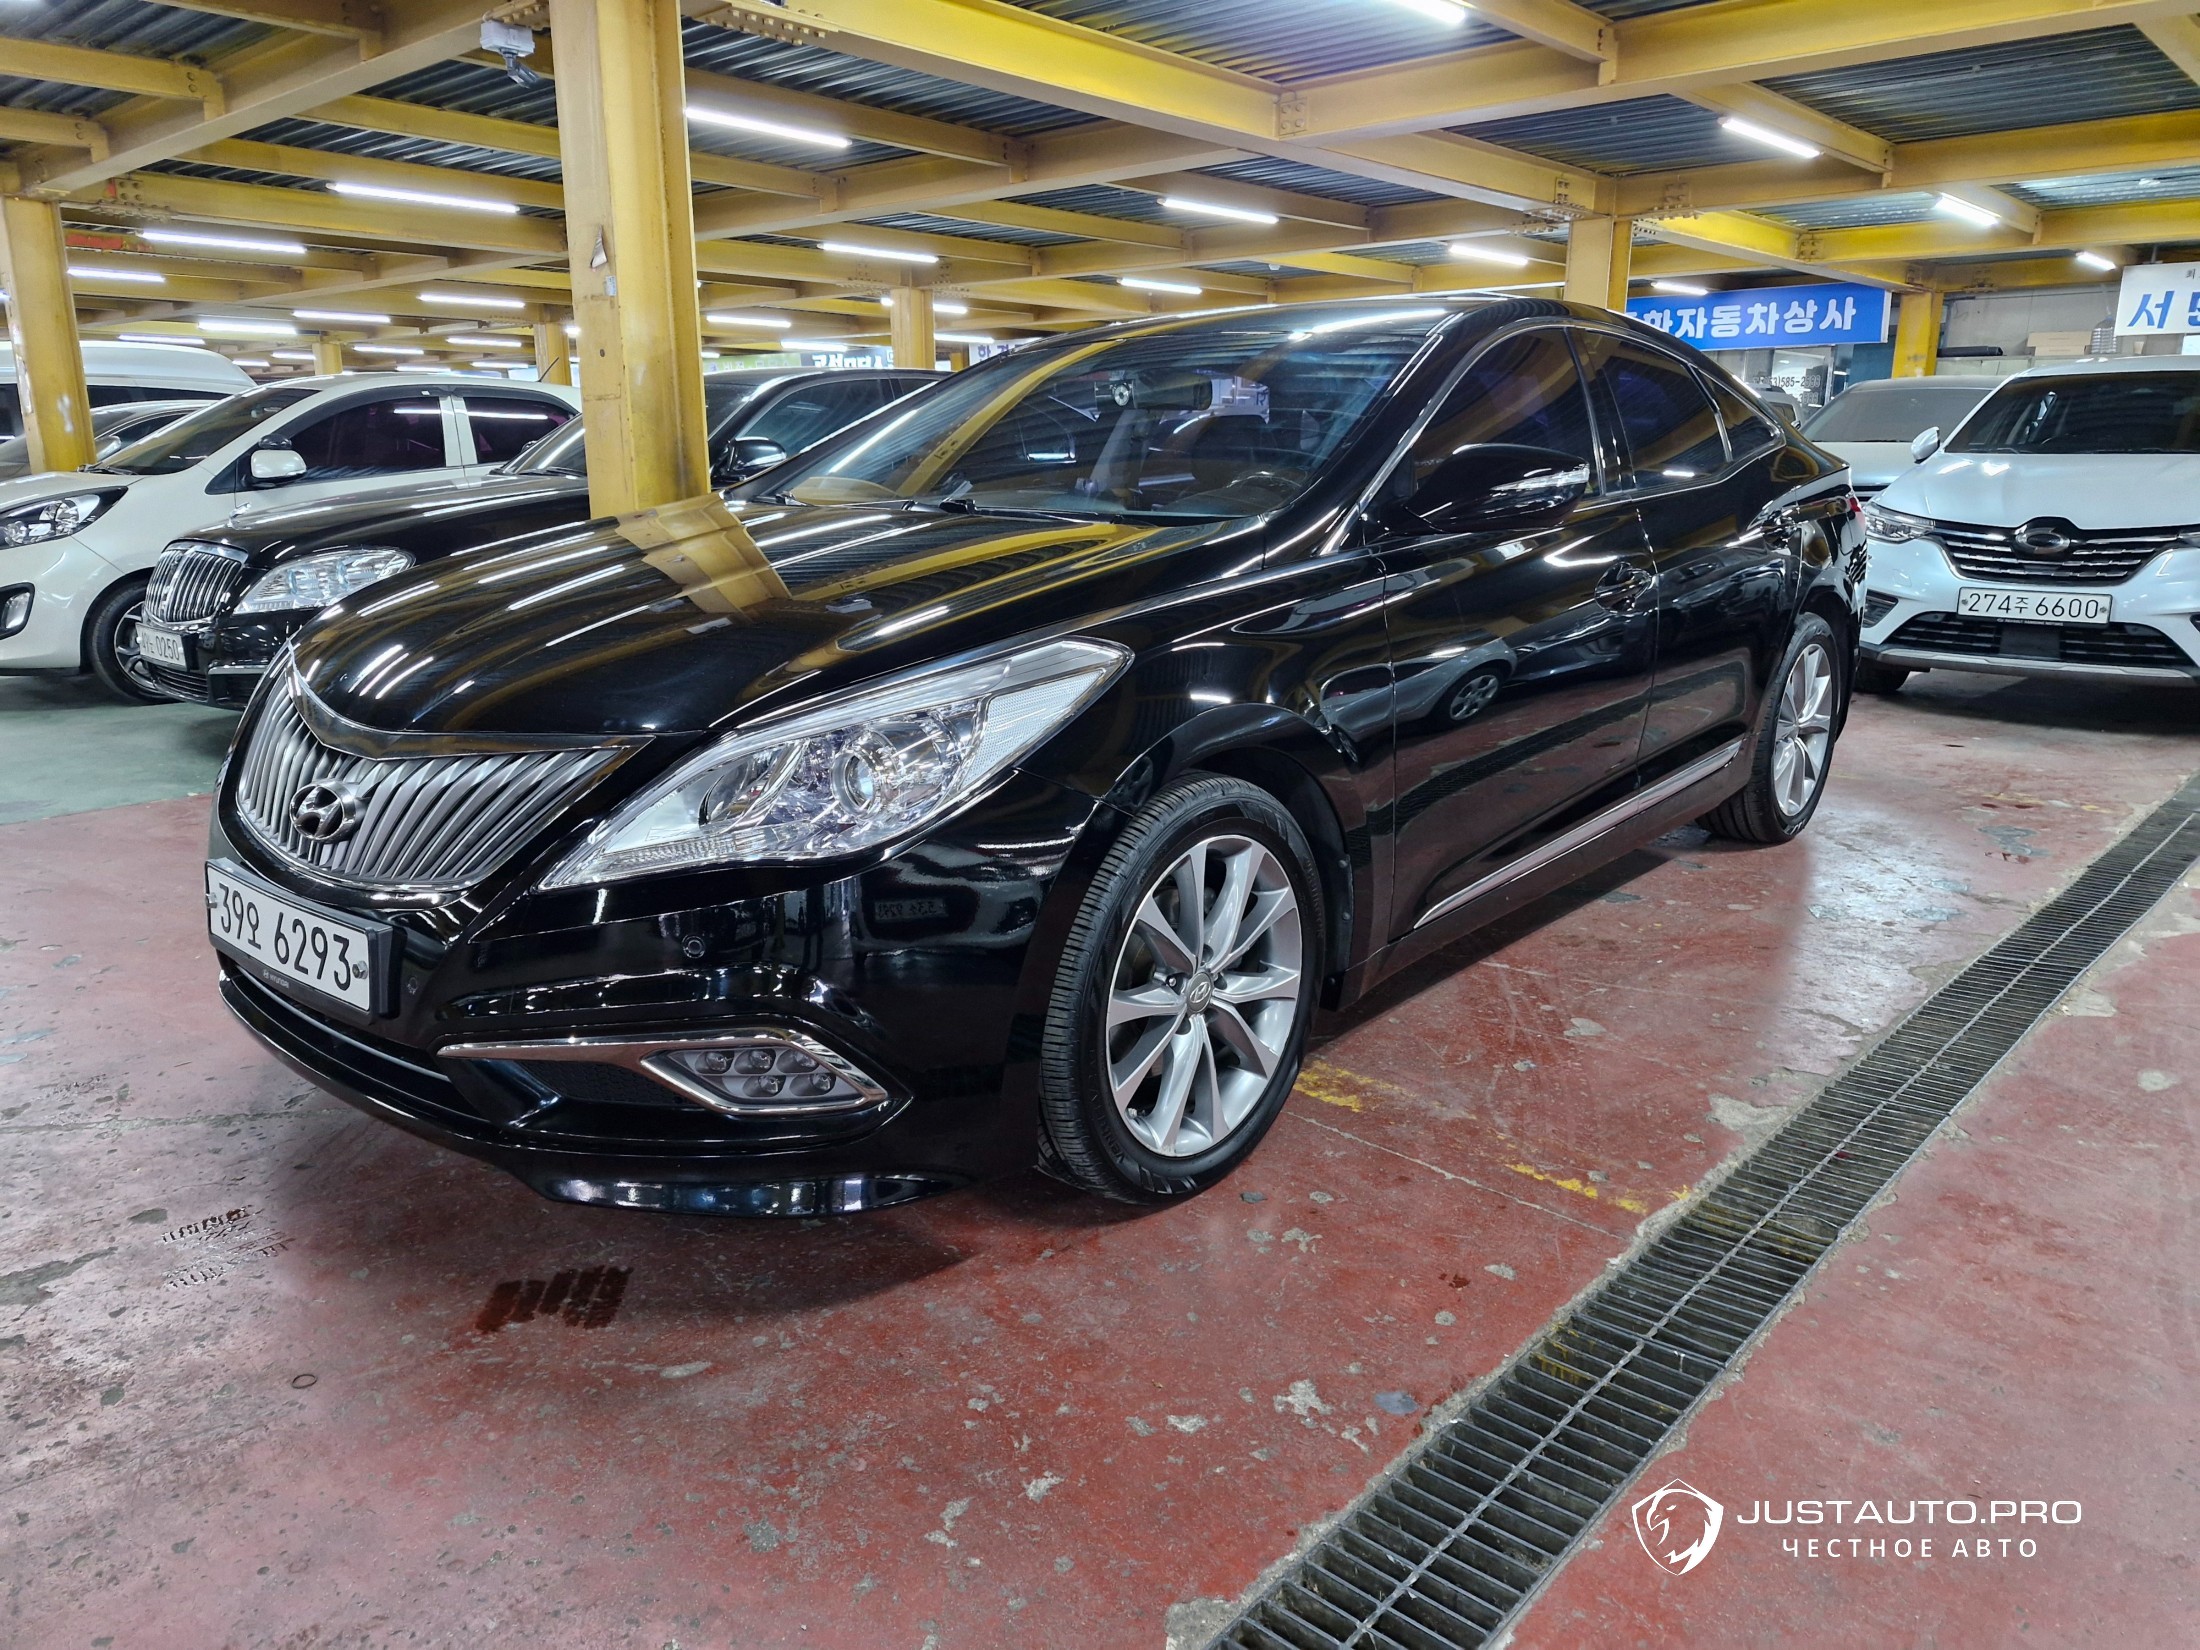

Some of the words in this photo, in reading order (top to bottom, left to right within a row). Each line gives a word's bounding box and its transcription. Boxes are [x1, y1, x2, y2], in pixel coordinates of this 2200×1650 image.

[1967, 592, 2029, 614] 274주
[2035, 597, 2099, 619] 6600
[156, 635, 180, 661] 0250
[219, 882, 262, 950] 39오
[274, 912, 352, 991] 6293
